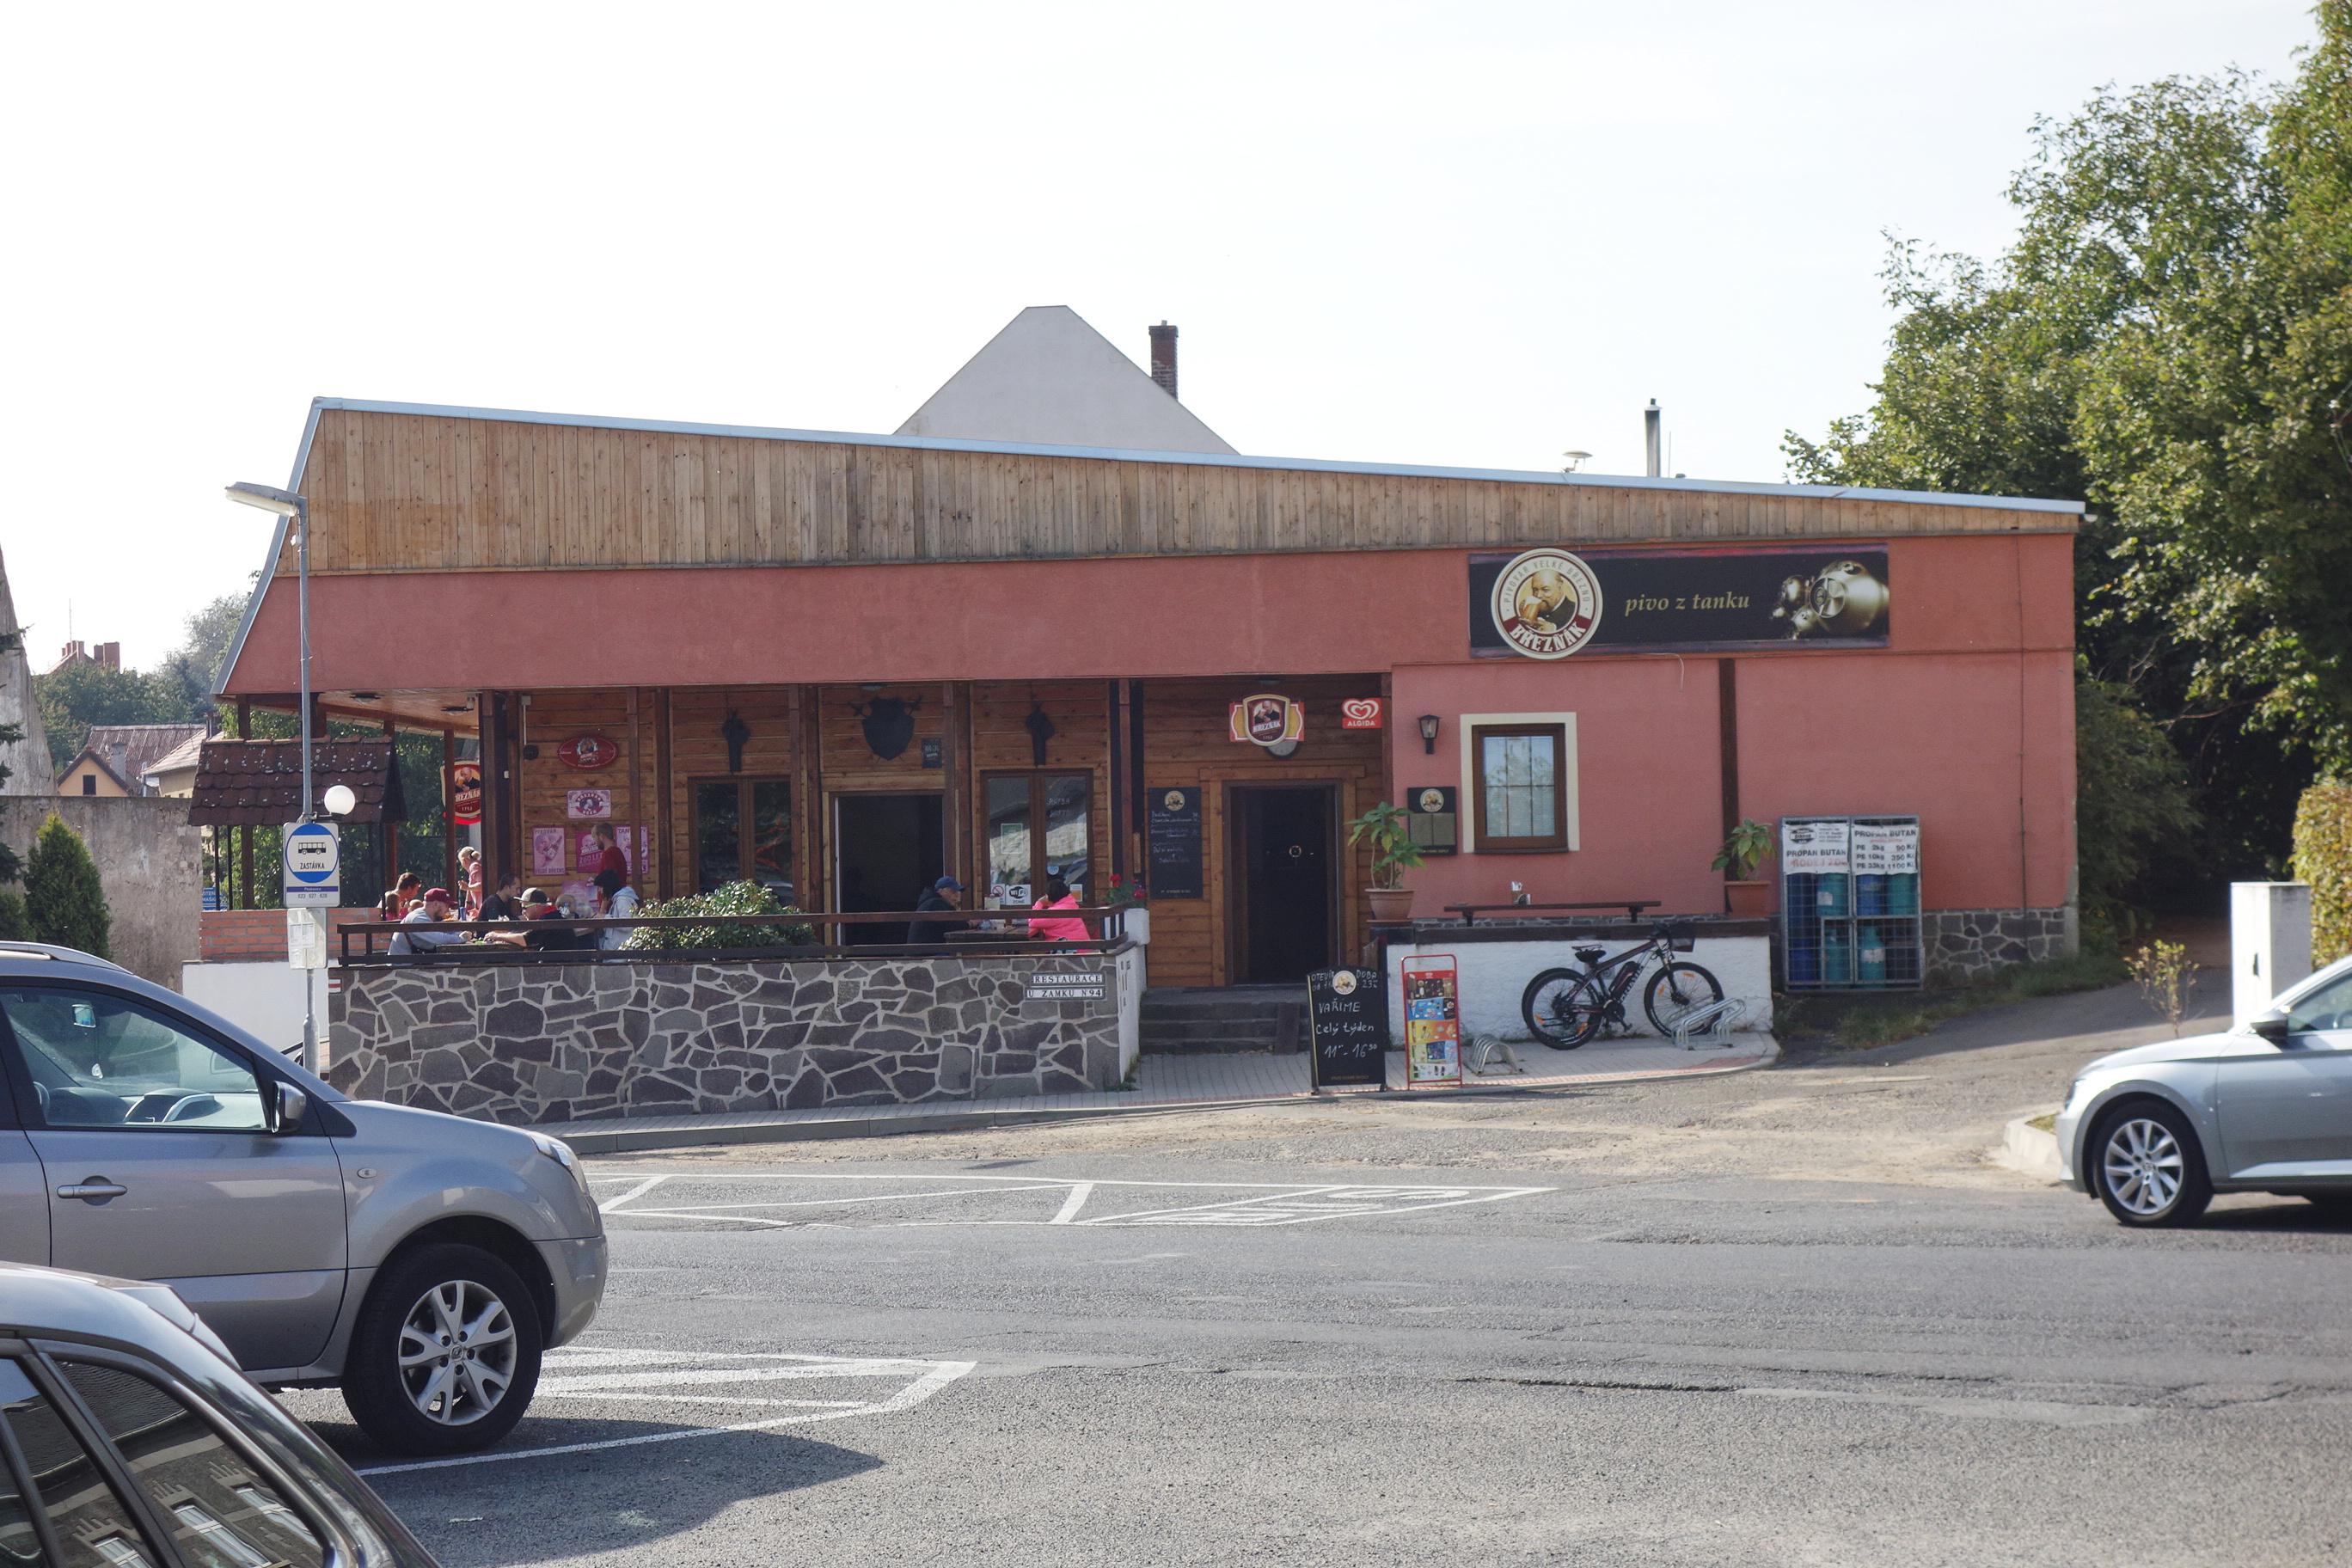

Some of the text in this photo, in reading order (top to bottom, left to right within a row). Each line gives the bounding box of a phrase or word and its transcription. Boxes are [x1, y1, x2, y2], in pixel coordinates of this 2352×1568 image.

[1504, 560, 1590, 603] PIVOVAR VELKÉ BŘEZNO
[1625, 591, 1750, 617] pivo z tanku
[1509, 621, 1587, 652] BŘEZŇÁK
[1034, 974, 1101, 983] RESTAURACE
[1356, 969, 1377, 980] DOBA
[1319, 997, 1361, 1014] VAŘÍME
[1343, 1021, 1375, 1036] týden
